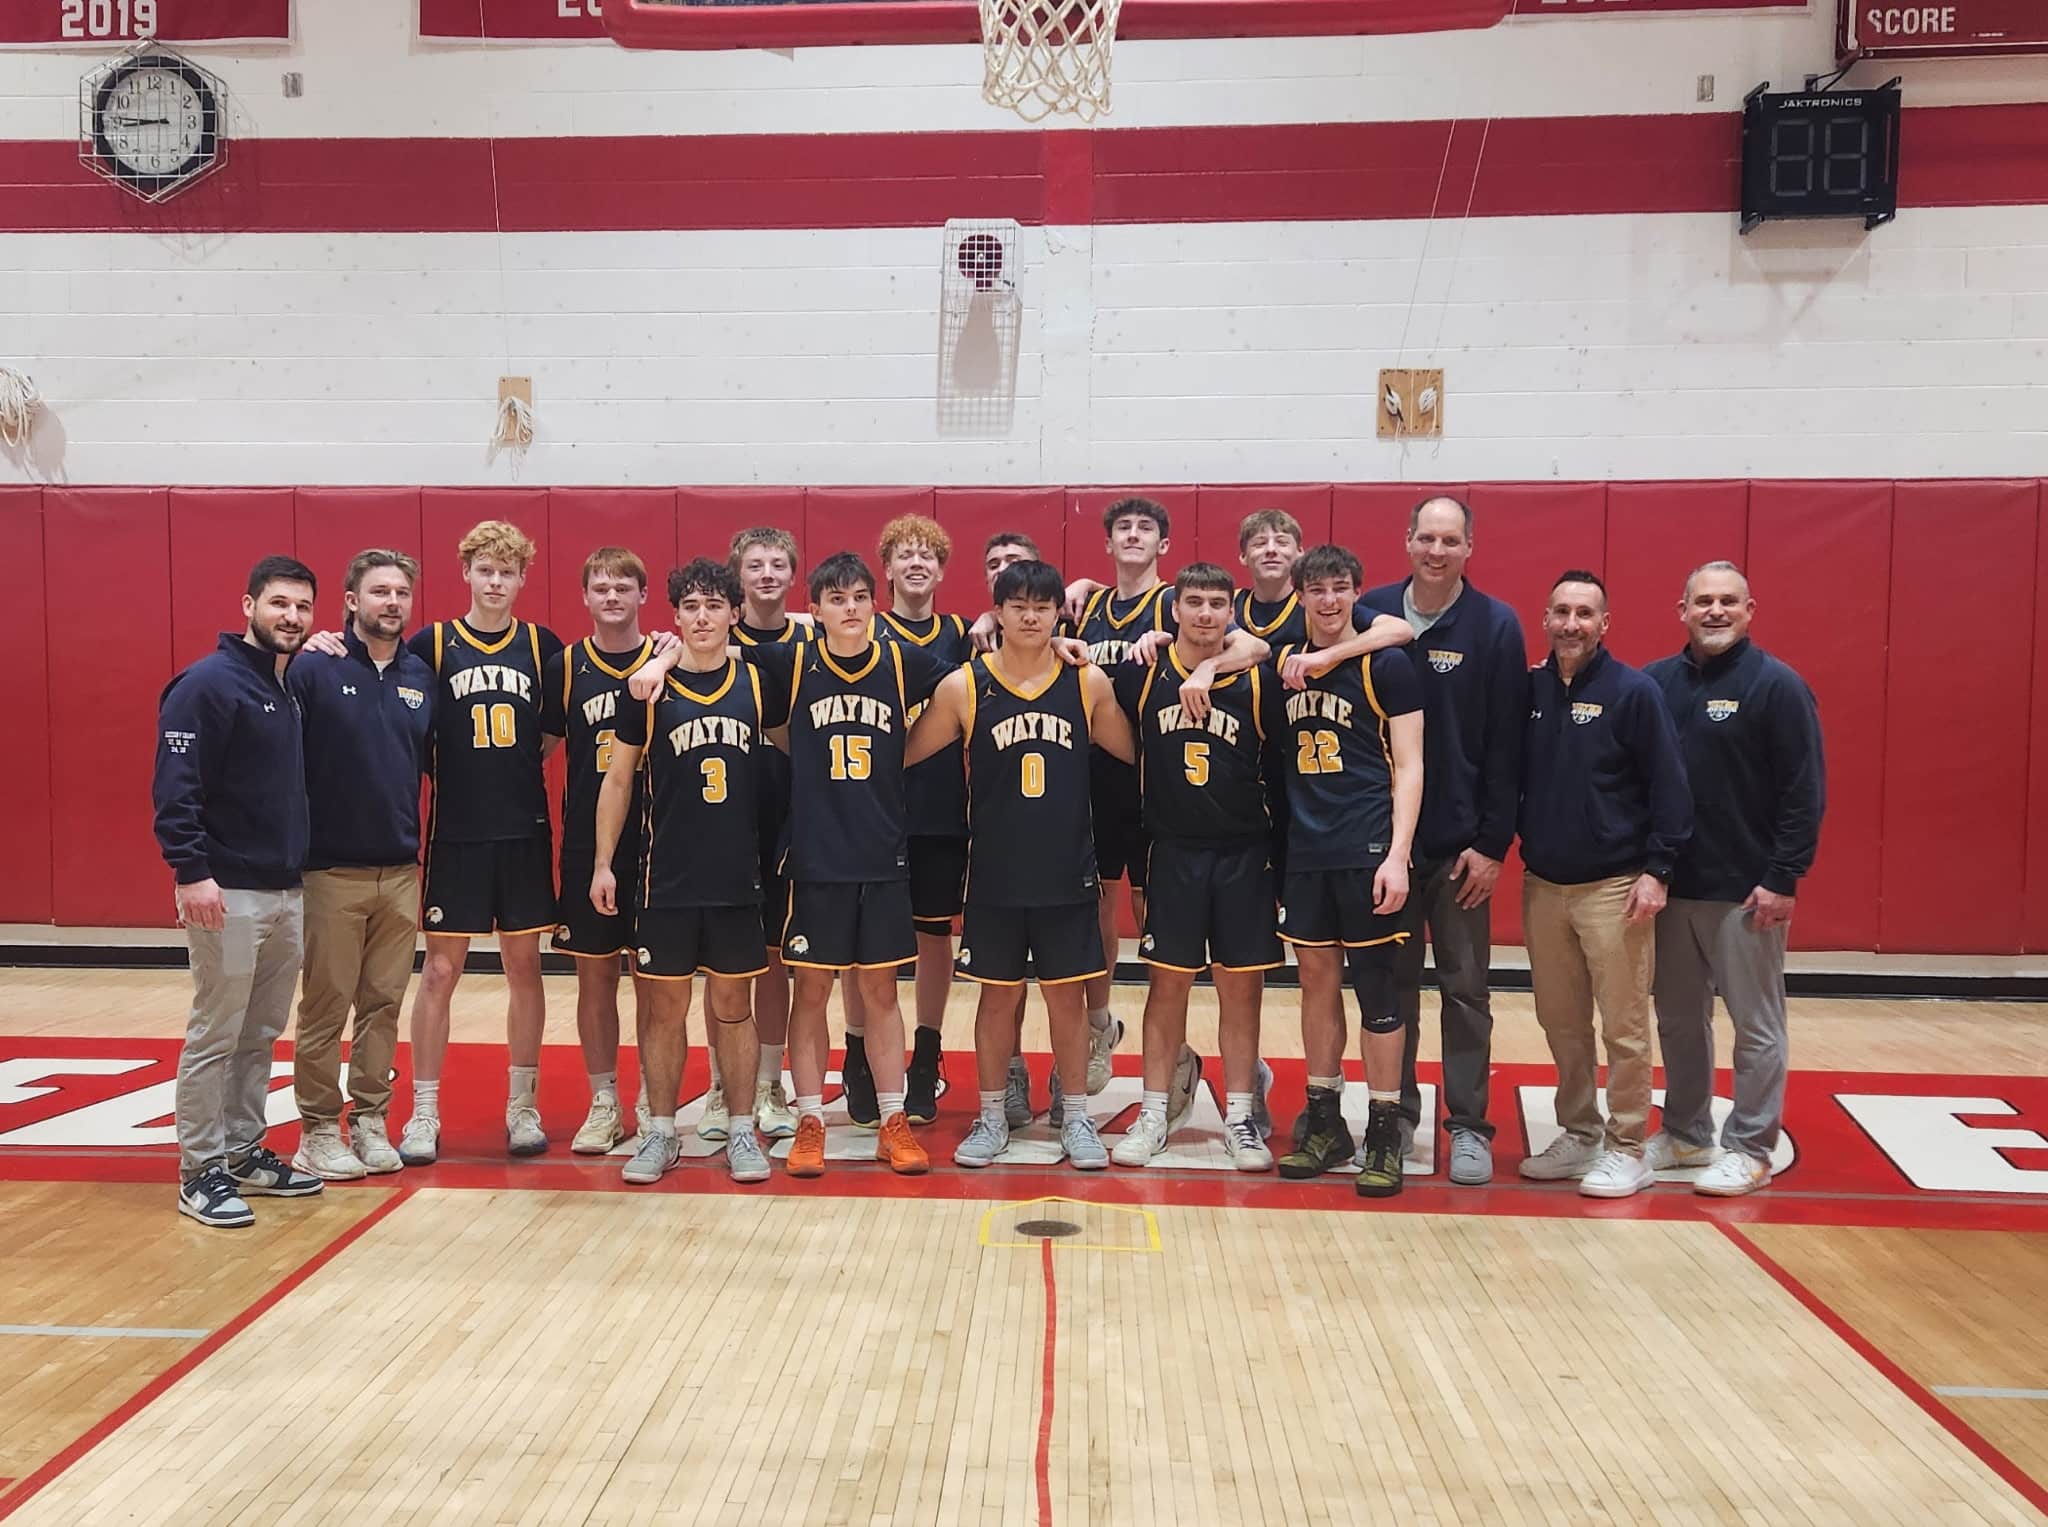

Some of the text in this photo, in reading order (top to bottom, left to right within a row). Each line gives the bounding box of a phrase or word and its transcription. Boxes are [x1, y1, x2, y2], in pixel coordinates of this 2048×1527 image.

[61, 0, 157, 37] 2019
[1867, 7, 1956, 35] SCORE
[147, 76, 162, 89] 12
[183, 96, 192, 109] 2
[187, 115, 197, 129] 3
[449, 664, 531, 704] WAYNE
[471, 703, 517, 748] 10
[809, 693, 892, 734] WAYNE
[1286, 690, 1353, 729] WAYNE
[668, 715, 751, 756] WAYNE
[991, 710, 1073, 751] WAYNE
[829, 735, 872, 780] 15
[1184, 741, 1210, 786] 5
[1297, 729, 1344, 774] 22
[700, 757, 728, 804] 3
[1021, 752, 1045, 798] 0
